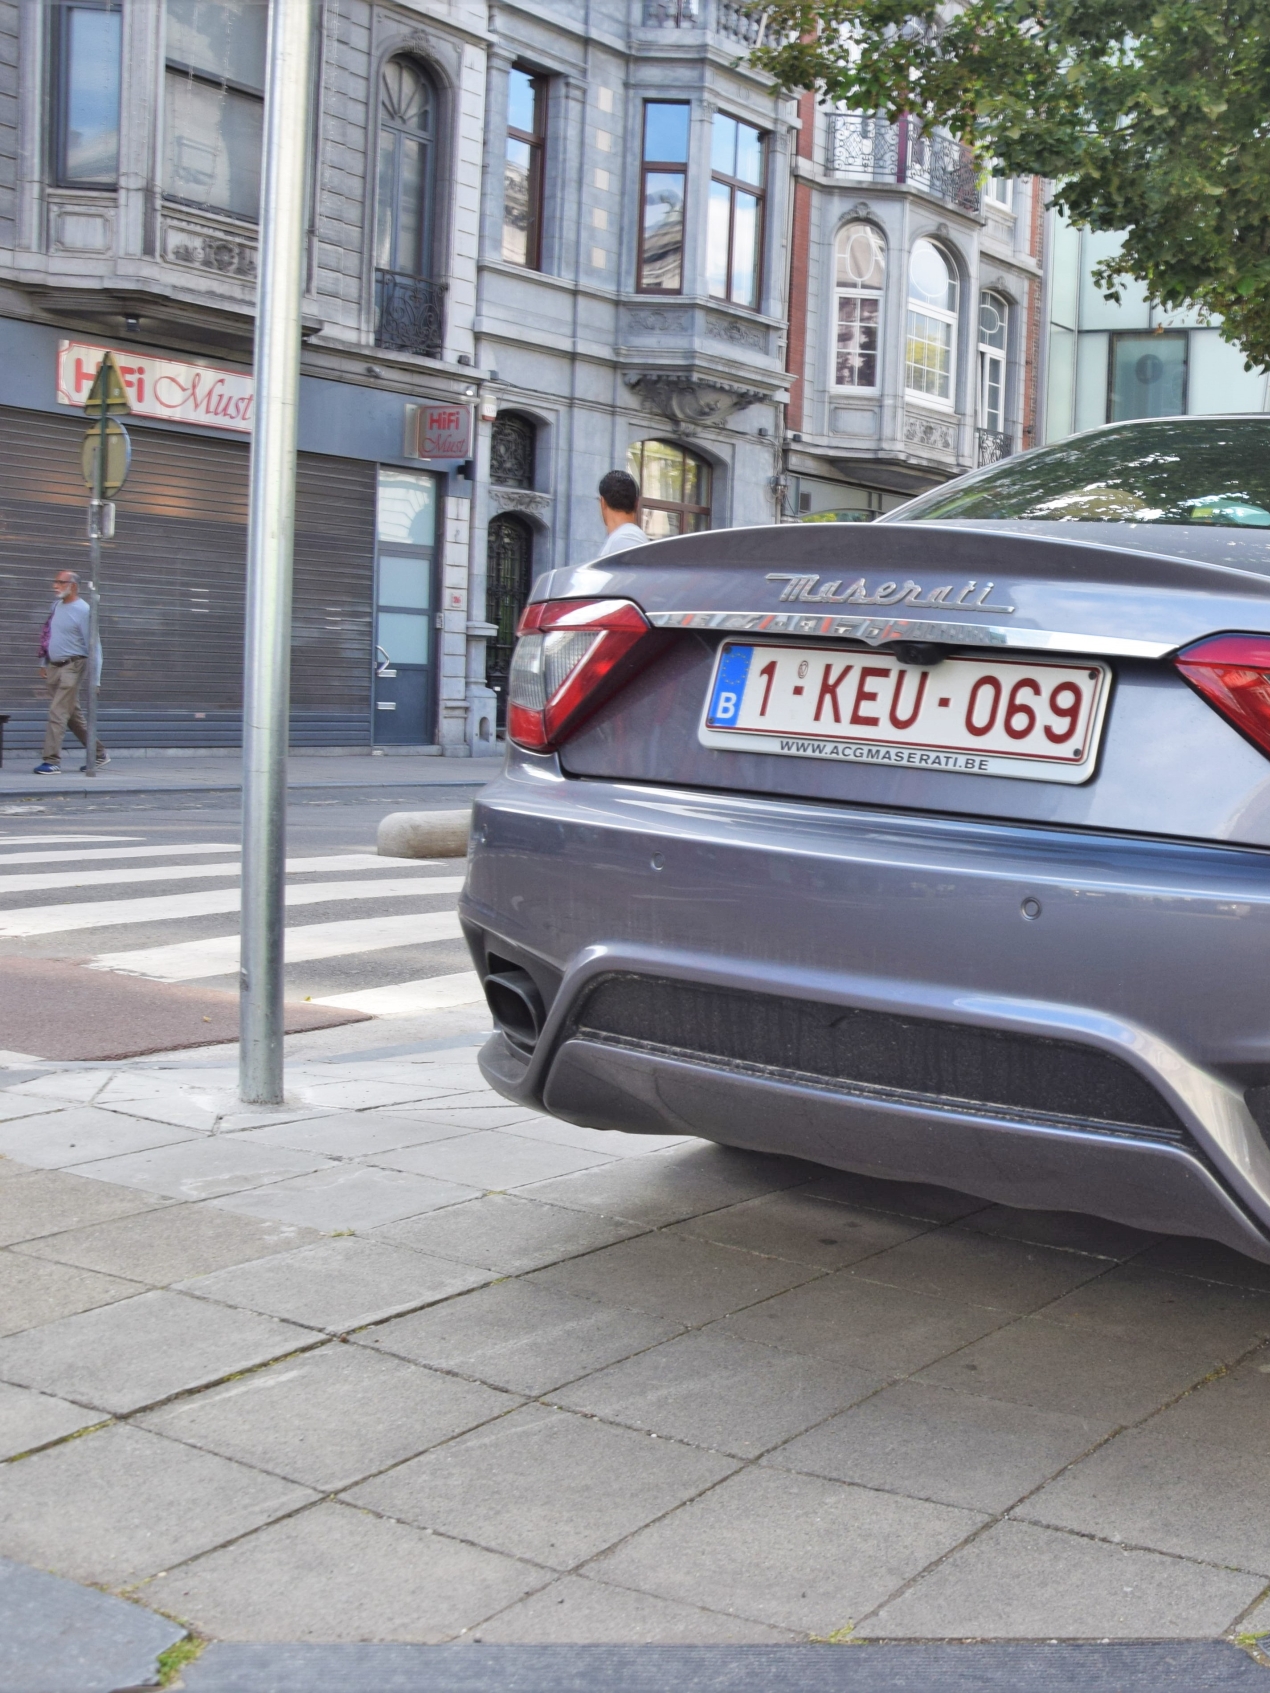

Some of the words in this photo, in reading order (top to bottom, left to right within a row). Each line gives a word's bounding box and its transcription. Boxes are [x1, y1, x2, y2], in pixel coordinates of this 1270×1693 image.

[428, 410, 460, 430] HiFi
[422, 434, 466, 453] Must
[764, 573, 1015, 614] Maserati
[716, 691, 737, 719] B
[780, 740, 989, 771] WWW.ACGMASERATI.BE
